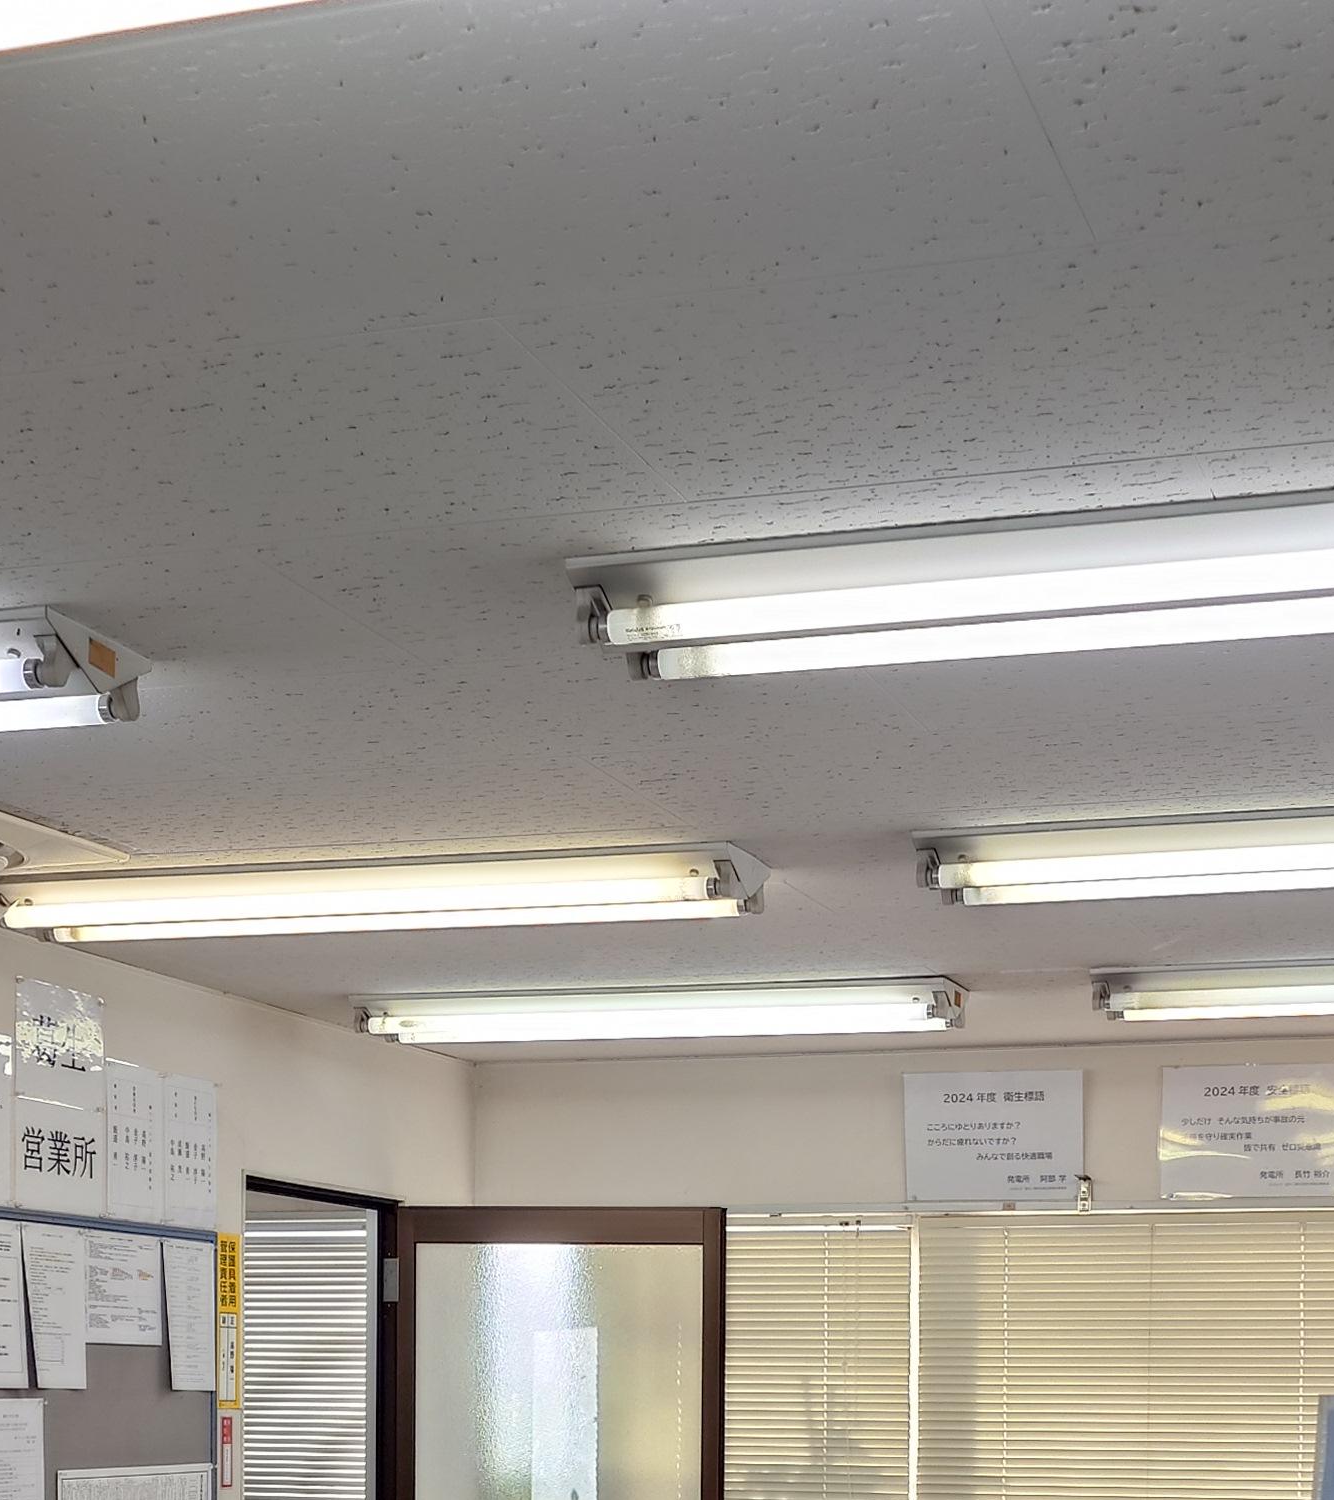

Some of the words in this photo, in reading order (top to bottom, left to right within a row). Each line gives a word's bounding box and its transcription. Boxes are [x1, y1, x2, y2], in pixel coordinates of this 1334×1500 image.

[1003, 1091, 1045, 1102] 衛生標語
[1181, 1118, 1212, 1126] 少しだけ
[1217, 1115, 1305, 1125] そんな気持ちが事故の元
[22, 1126, 97, 1179] 営業所
